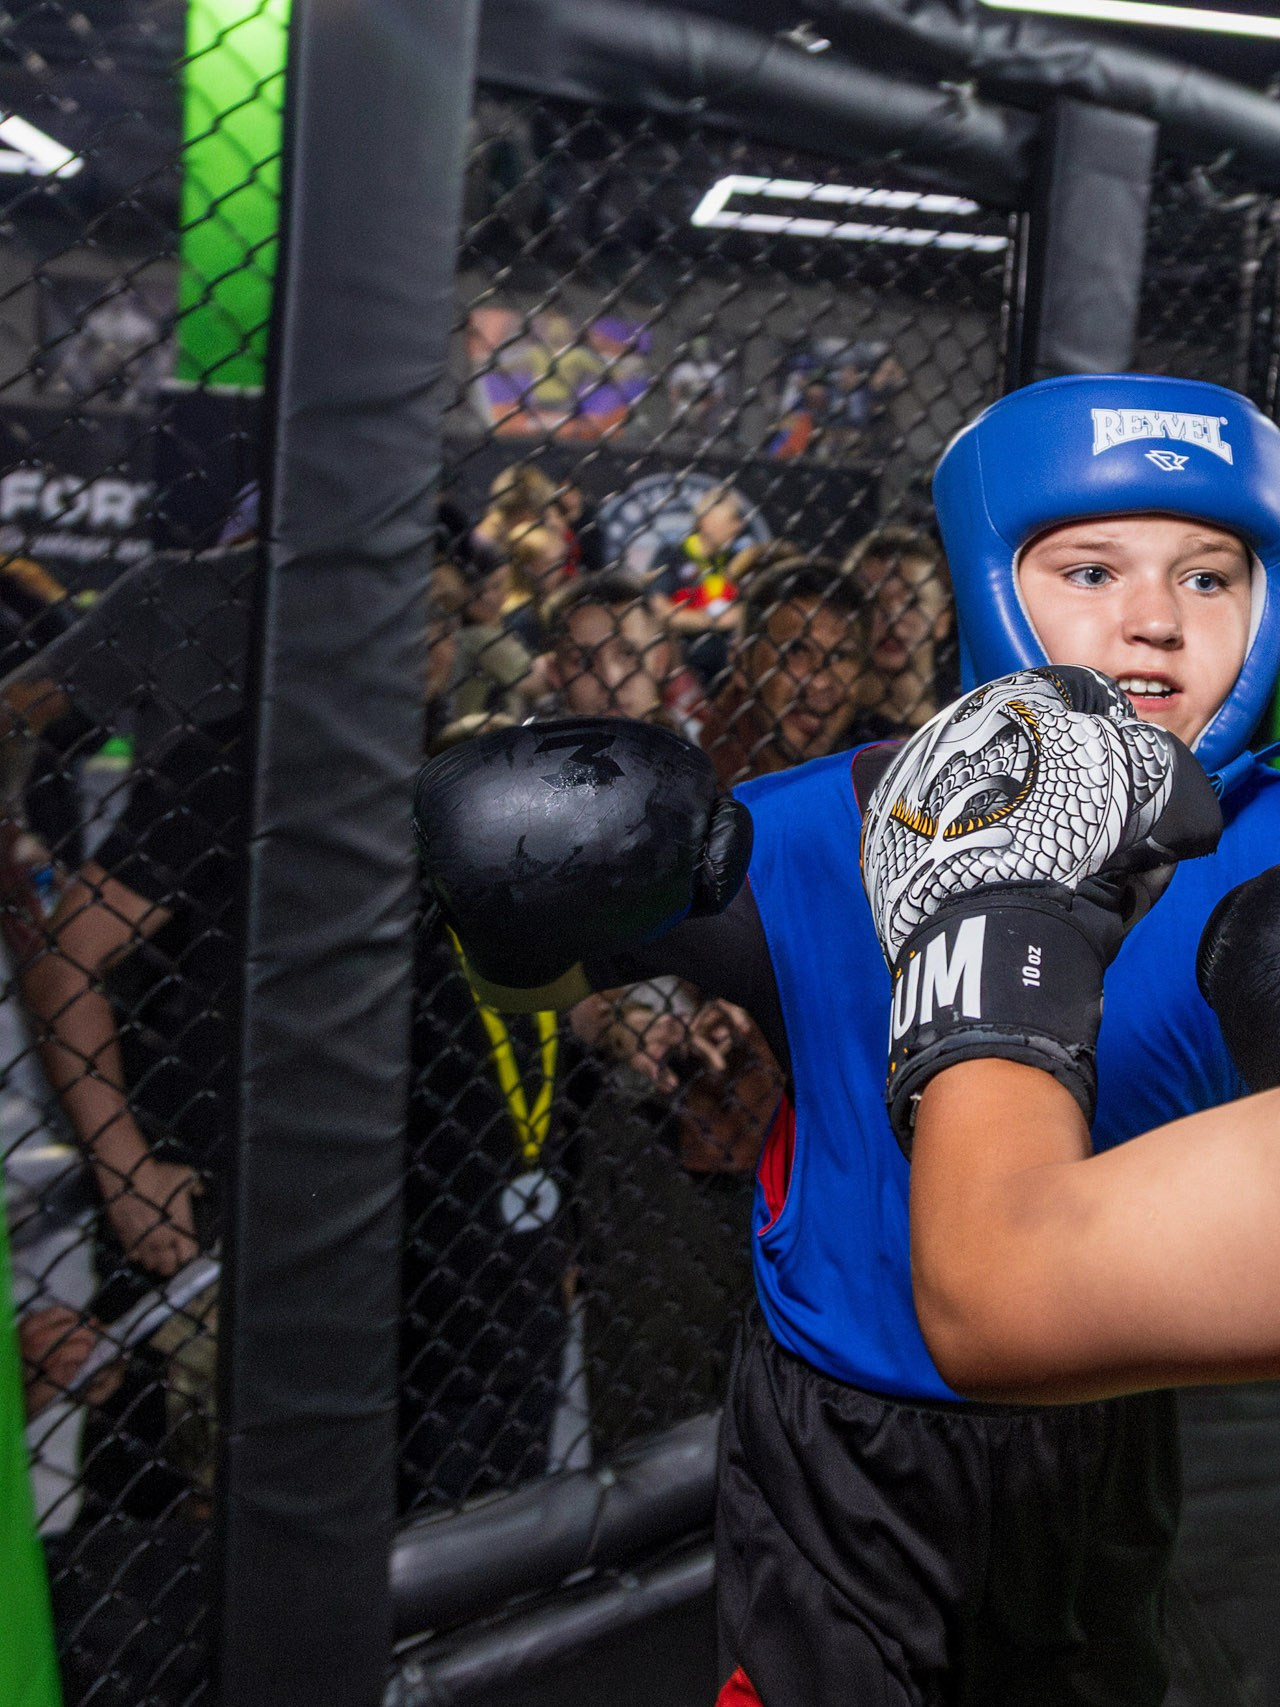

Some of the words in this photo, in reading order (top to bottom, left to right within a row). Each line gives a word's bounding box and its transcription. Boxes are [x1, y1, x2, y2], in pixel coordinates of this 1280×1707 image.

[1091, 408, 1234, 466] REYVEL
[888, 914, 987, 1057] UM
[1021, 966, 1042, 988] 10
